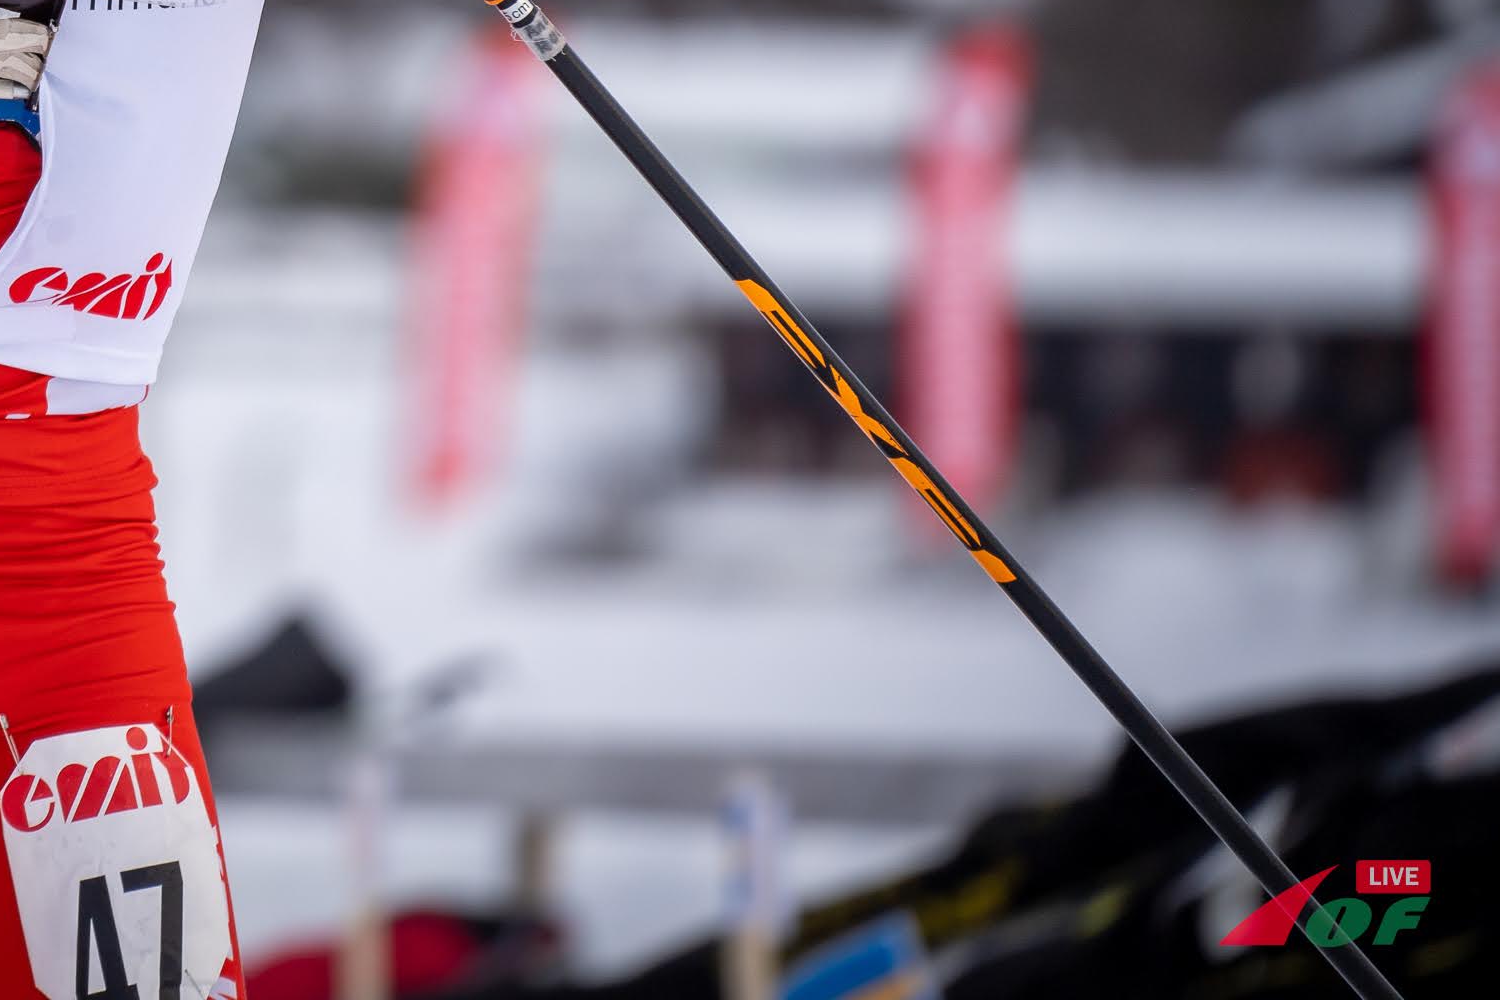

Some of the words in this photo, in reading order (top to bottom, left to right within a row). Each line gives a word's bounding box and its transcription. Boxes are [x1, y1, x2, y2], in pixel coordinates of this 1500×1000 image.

[9, 251, 173, 320] emit
[0, 726, 192, 833] emit
[76, 861, 184, 1000] 47
